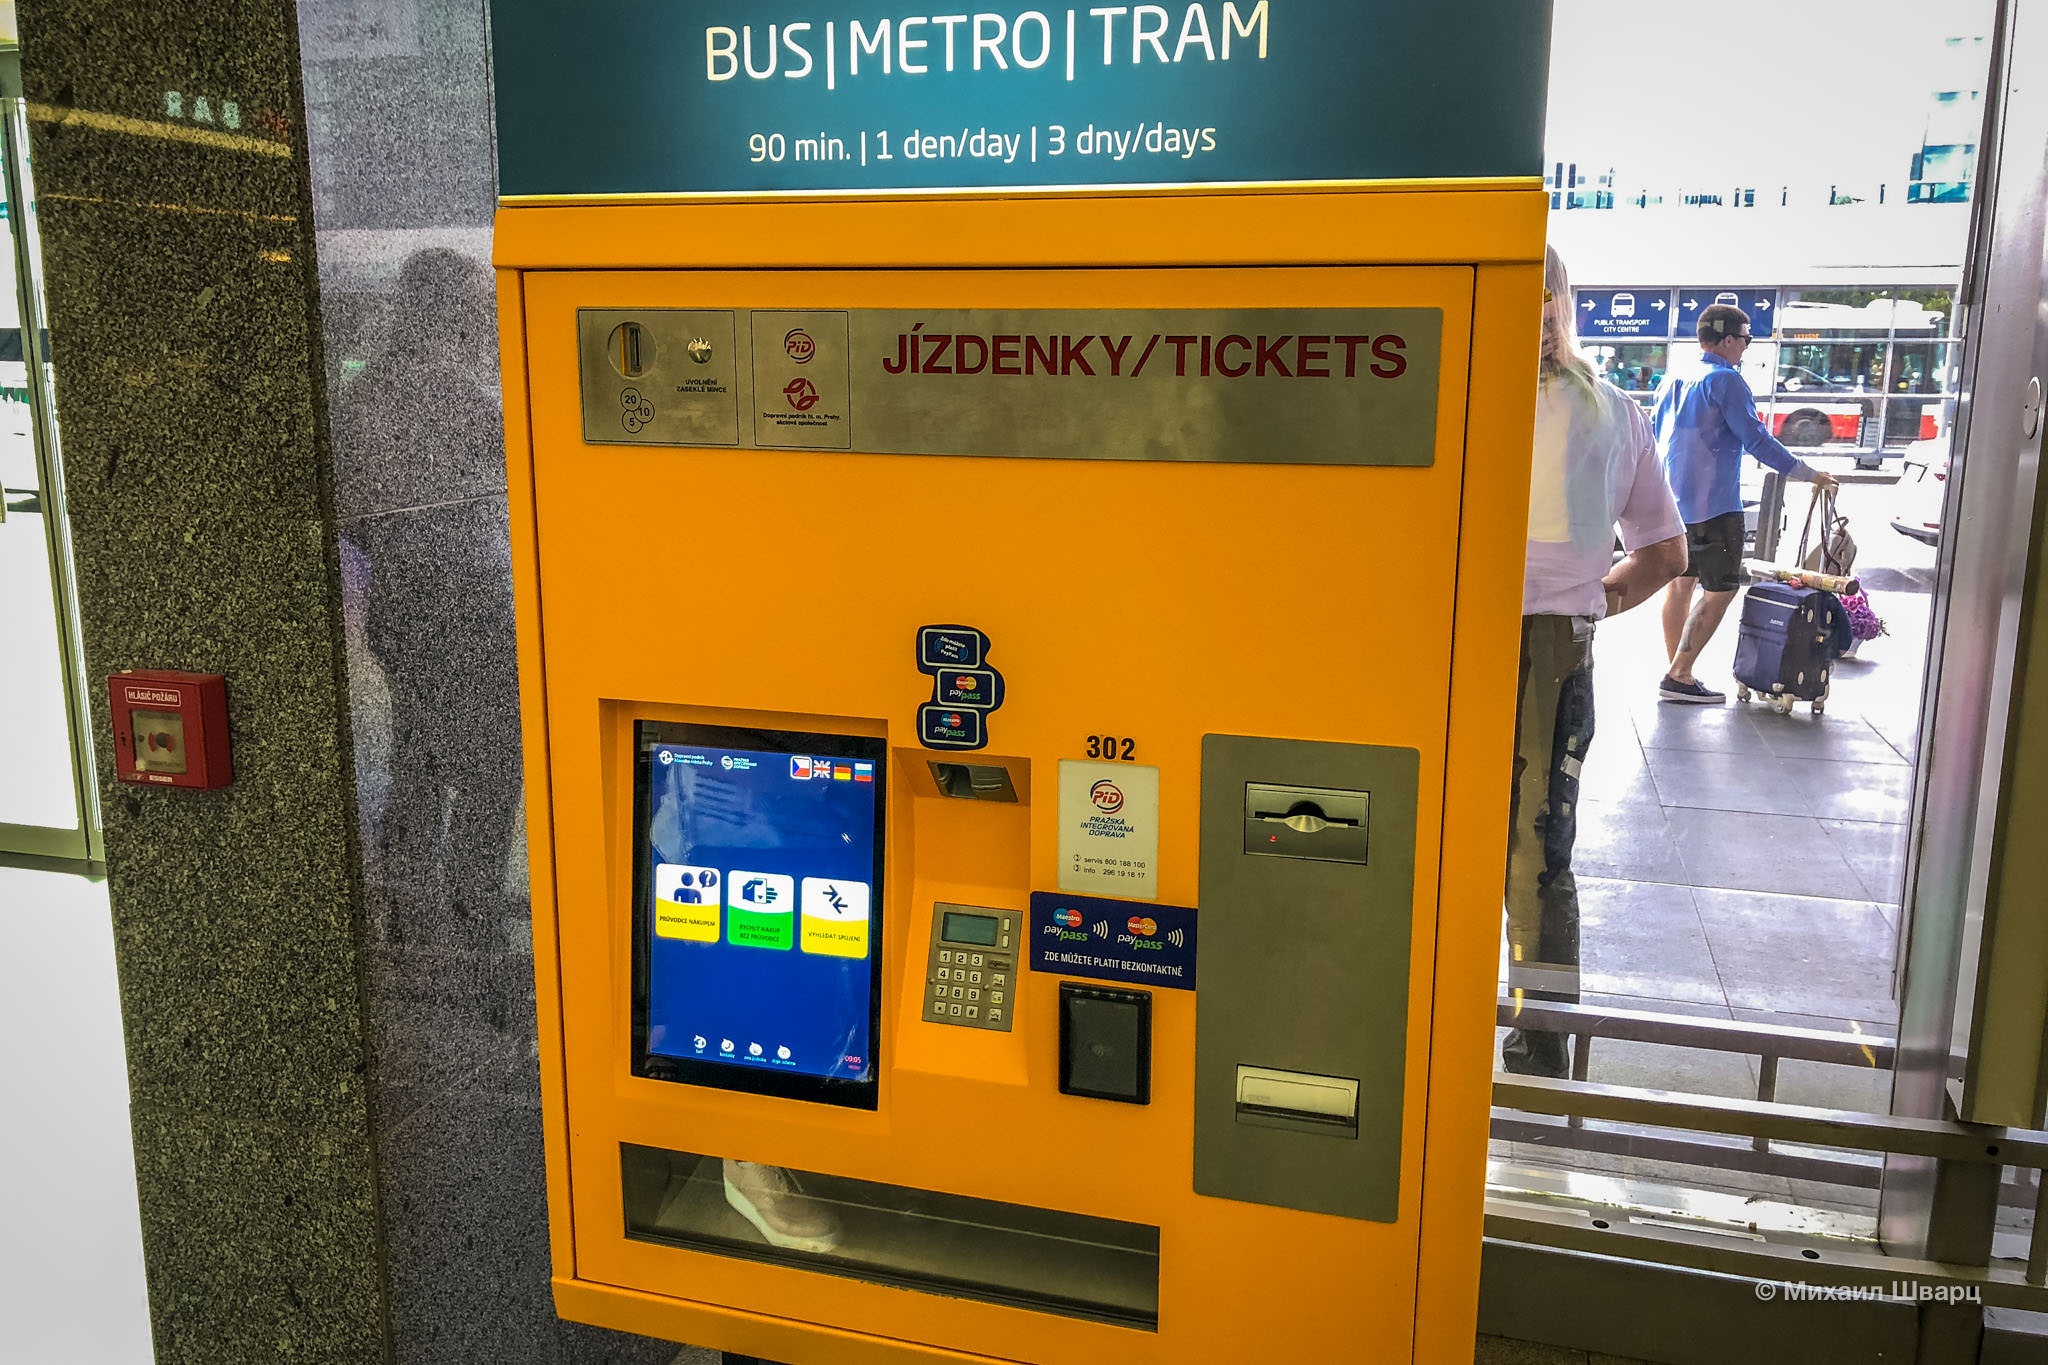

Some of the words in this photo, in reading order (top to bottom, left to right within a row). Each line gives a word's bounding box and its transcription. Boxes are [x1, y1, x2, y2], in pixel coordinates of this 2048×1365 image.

[749, 132, 786, 163] 90
[794, 130, 852, 161] min.
[876, 130, 893, 160] 1
[903, 126, 1020, 163] den/day
[1048, 125, 1066, 155] 3
[1076, 122, 1217, 160] dny/days
[882, 323, 1408, 379] JÍZDENKY/TICKETS
[624, 394, 637, 405] 20
[638, 406, 650, 418] 10
[628, 417, 636, 427] 5
[128, 690, 152, 701] HLÁSIČ
[151, 692, 178, 703] POŽÁRU
[1086, 735, 1135, 761] 302
[1089, 816, 1125, 825] PRAŽSKÁ
[1080, 821, 1135, 833] INTEGROVANÁ
[1088, 829, 1126, 839] DOPRAVA
[1083, 856, 1103, 865] servis
[1133, 861, 1146, 869] 100
[1083, 866, 1096, 875] info
[1117, 869, 1126, 877] 19
[1137, 872, 1146, 880] 17
[659, 915, 689, 925] PRŮVODCE
[1056, 913, 1081, 922] Maestro
[739, 932, 750, 940] BEZ
[750, 933, 780, 943] PRŮVODCE
[808, 931, 838, 940] VYHLEDAT
[973, 956, 980, 964] 3
[1044, 951, 1060, 961] ZDE
[1060, 952, 1092, 966] MŮŽETE
[1093, 957, 1120, 969] PLATIT
[1121, 960, 1183, 977] BEZKONTAKTNĚ
[956, 971, 962, 979] 5
[972, 973, 978, 981] 6
[939, 987, 945, 995] 7
[954, 989, 961, 997] 8
[970, 991, 976, 999] 9
[952, 1006, 958, 1015] 0
